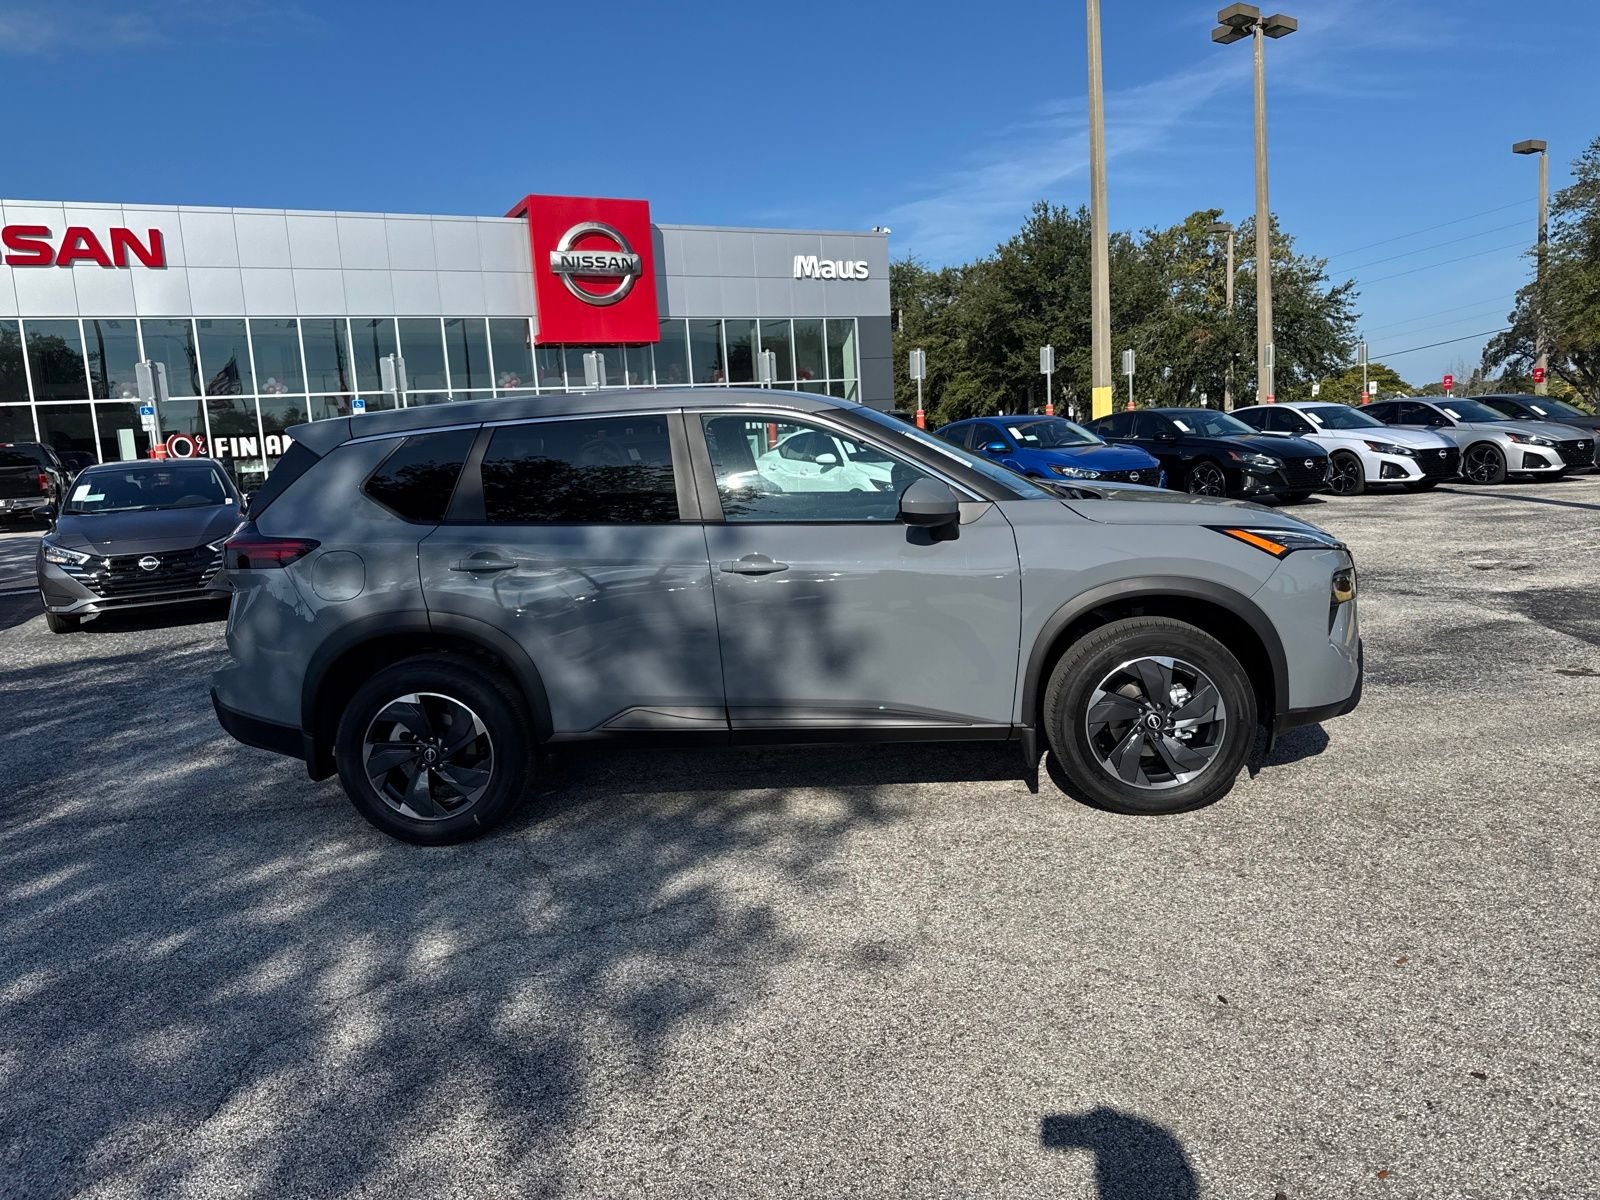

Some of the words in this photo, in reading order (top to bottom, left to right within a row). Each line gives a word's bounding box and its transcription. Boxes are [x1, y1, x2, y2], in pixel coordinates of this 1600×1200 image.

[0, 225, 165, 268] SAN
[560, 256, 634, 270] NISSAN
[793, 255, 870, 280] Maus
